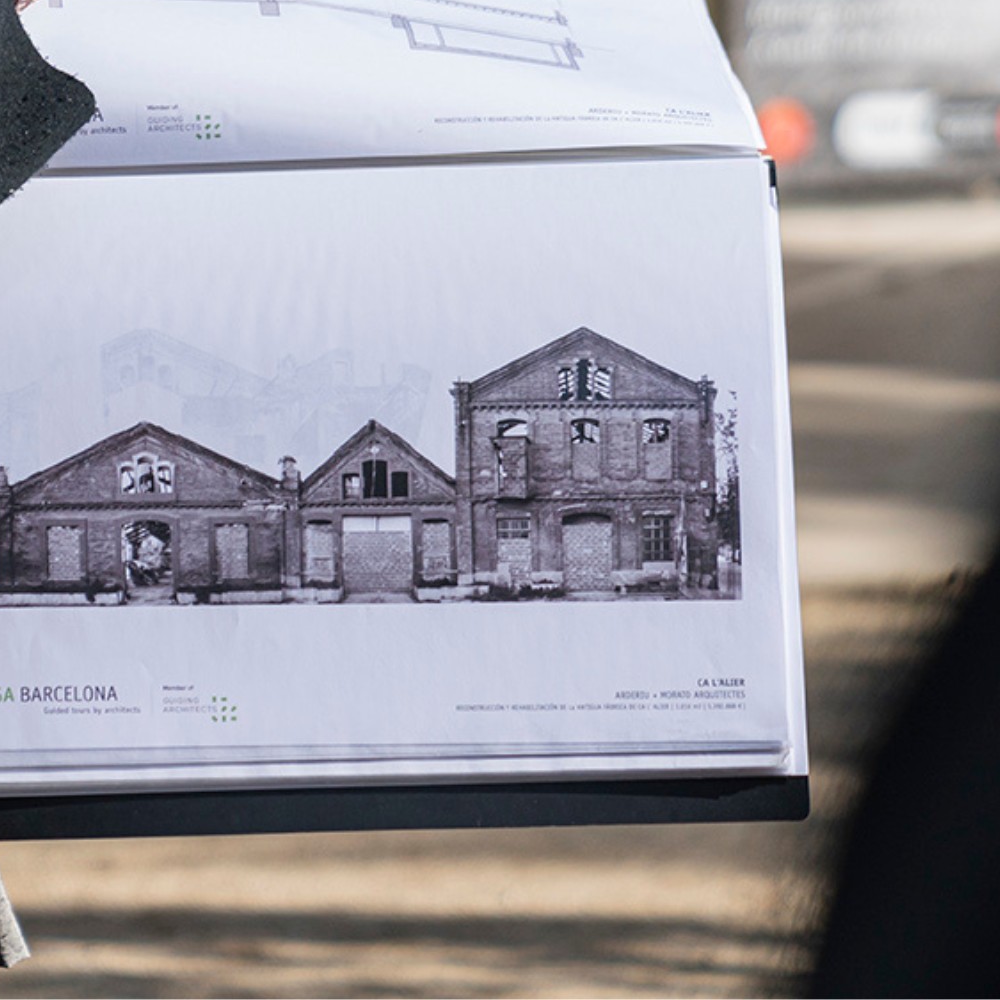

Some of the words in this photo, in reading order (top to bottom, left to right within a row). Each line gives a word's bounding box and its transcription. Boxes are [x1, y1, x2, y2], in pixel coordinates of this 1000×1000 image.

[90, 126, 127, 135] architects
[147, 123, 202, 133] ARCHITECTS
[697, 678, 710, 688] CA
[20, 685, 119, 703] BARCELONA
[43, 706, 69, 715] Guided
[71, 706, 91, 715] tours
[92, 705, 102, 716] by
[104, 704, 142, 715] architects
[162, 705, 218, 714] ARCHITECTS
